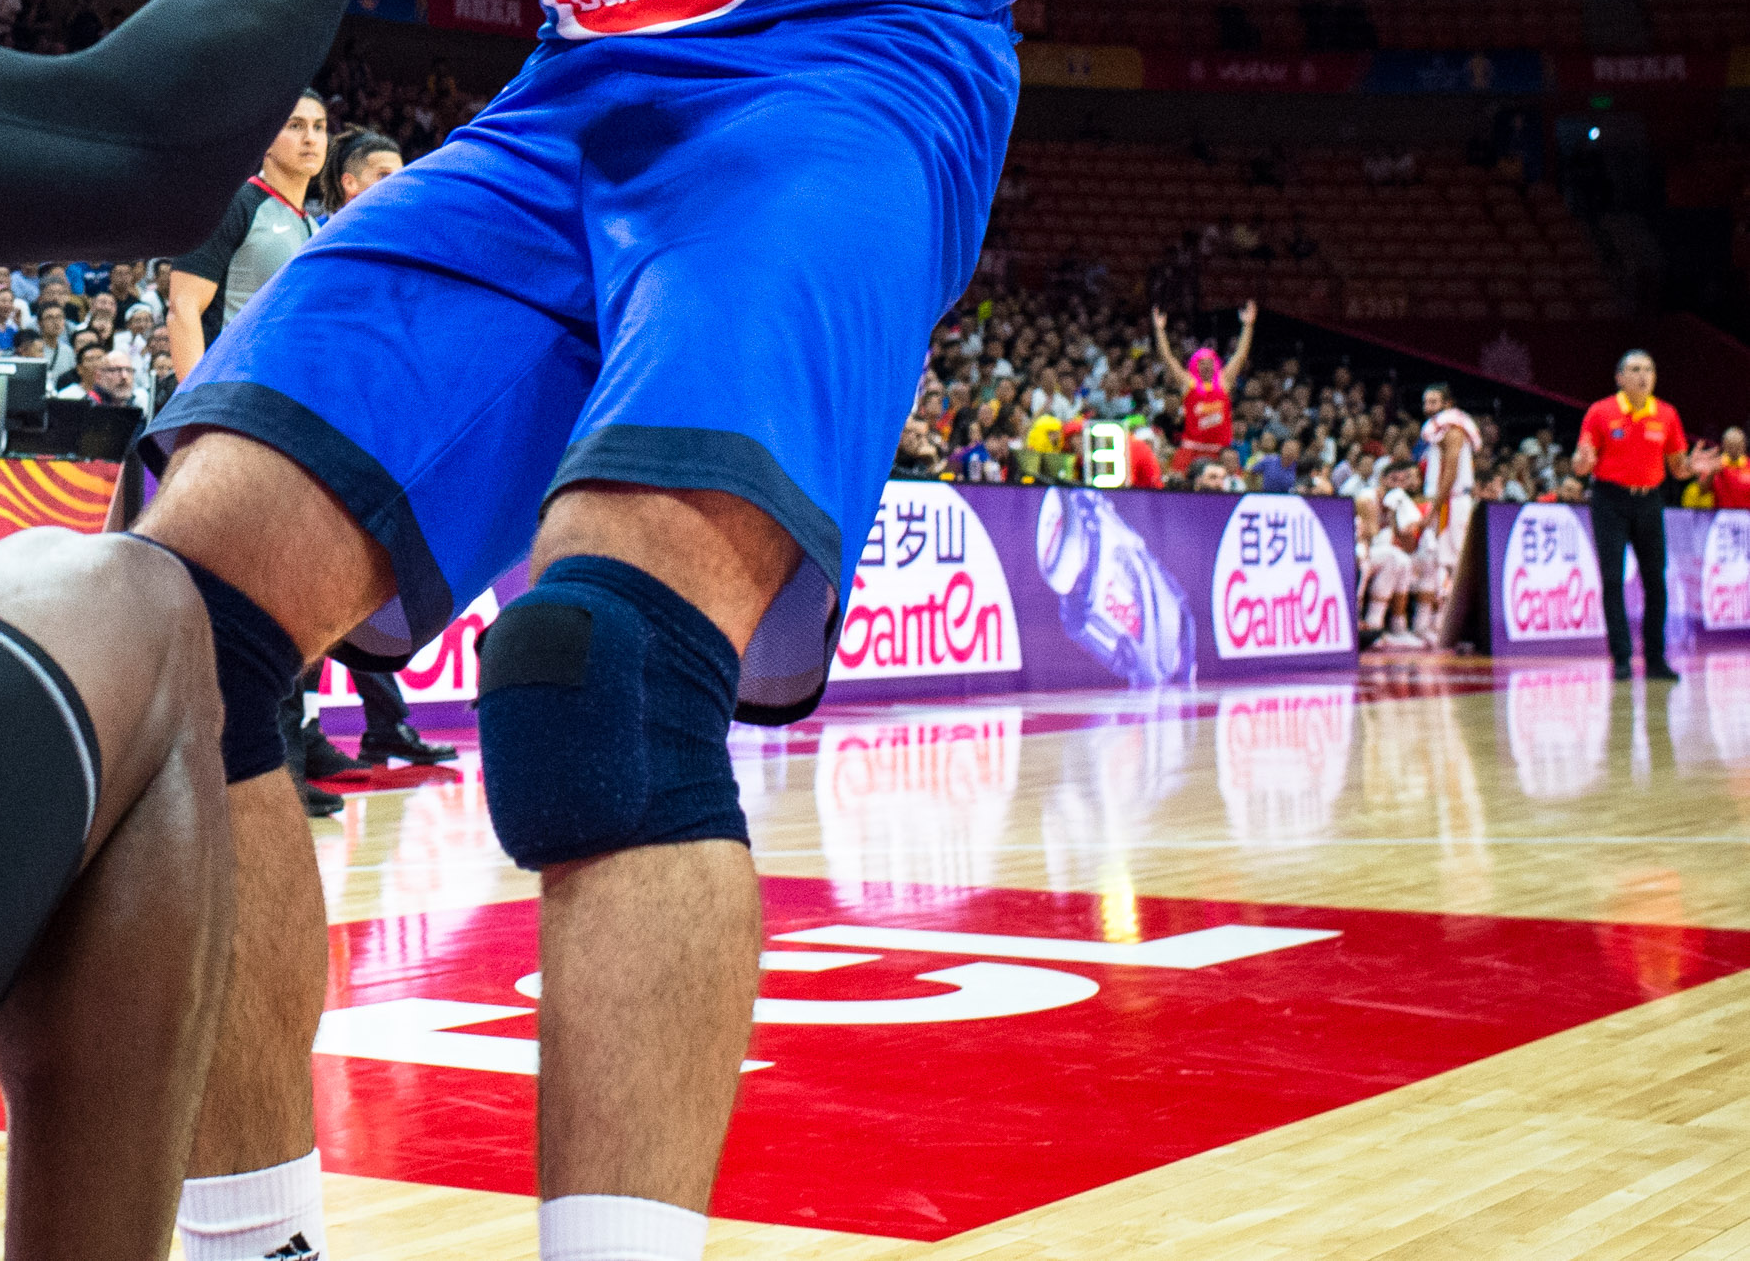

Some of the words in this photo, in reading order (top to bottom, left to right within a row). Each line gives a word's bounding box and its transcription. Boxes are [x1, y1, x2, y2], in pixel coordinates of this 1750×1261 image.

[1091, 422, 1126, 488] 3
[1240, 512, 1314, 567] 百岁山
[1225, 569, 1339, 648] Ganten
